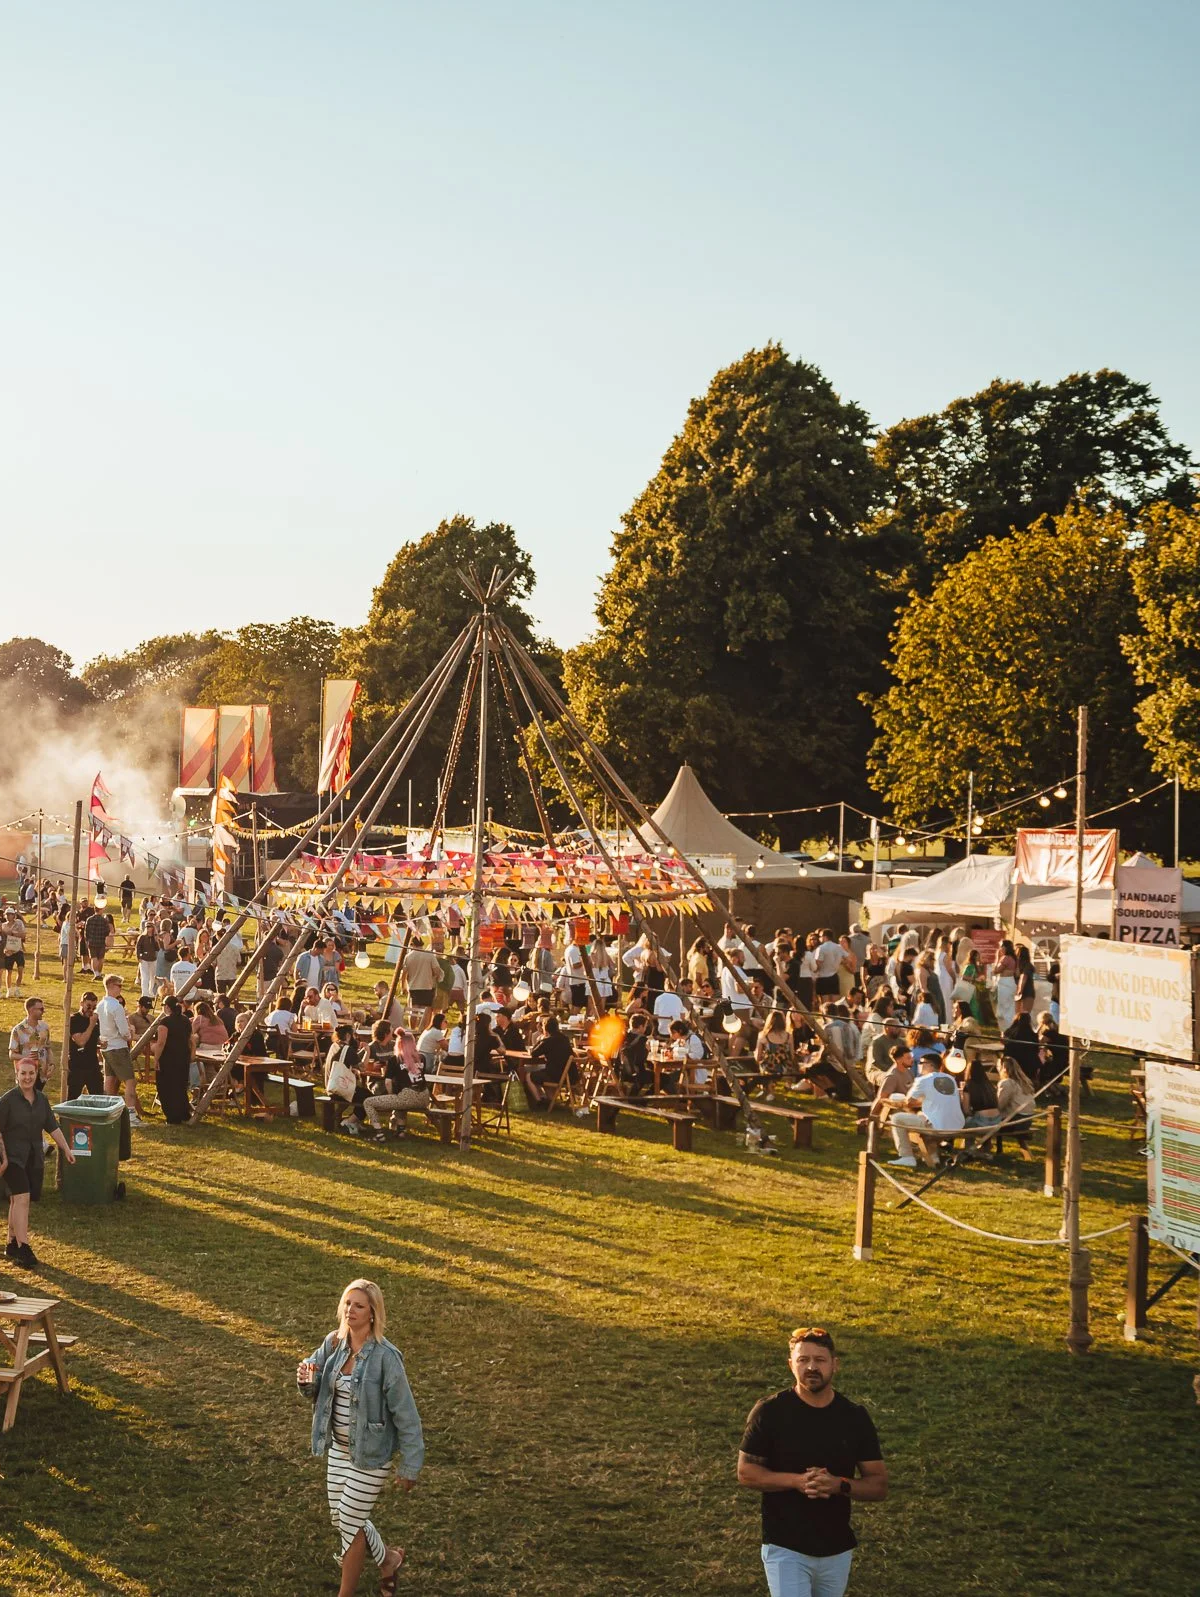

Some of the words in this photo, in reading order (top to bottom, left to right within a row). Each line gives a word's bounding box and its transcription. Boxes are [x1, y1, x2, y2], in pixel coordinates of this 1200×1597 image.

[1119, 892, 1177, 904] HANDMADE
[1117, 907, 1180, 920] SOURDOUGH
[1119, 924, 1177, 945] PIZZA
[1071, 964, 1129, 993] COOKING
[1132, 974, 1181, 1001] DEMOS
[1096, 994, 1106, 1014] &
[1109, 996, 1152, 1023] TALKS
